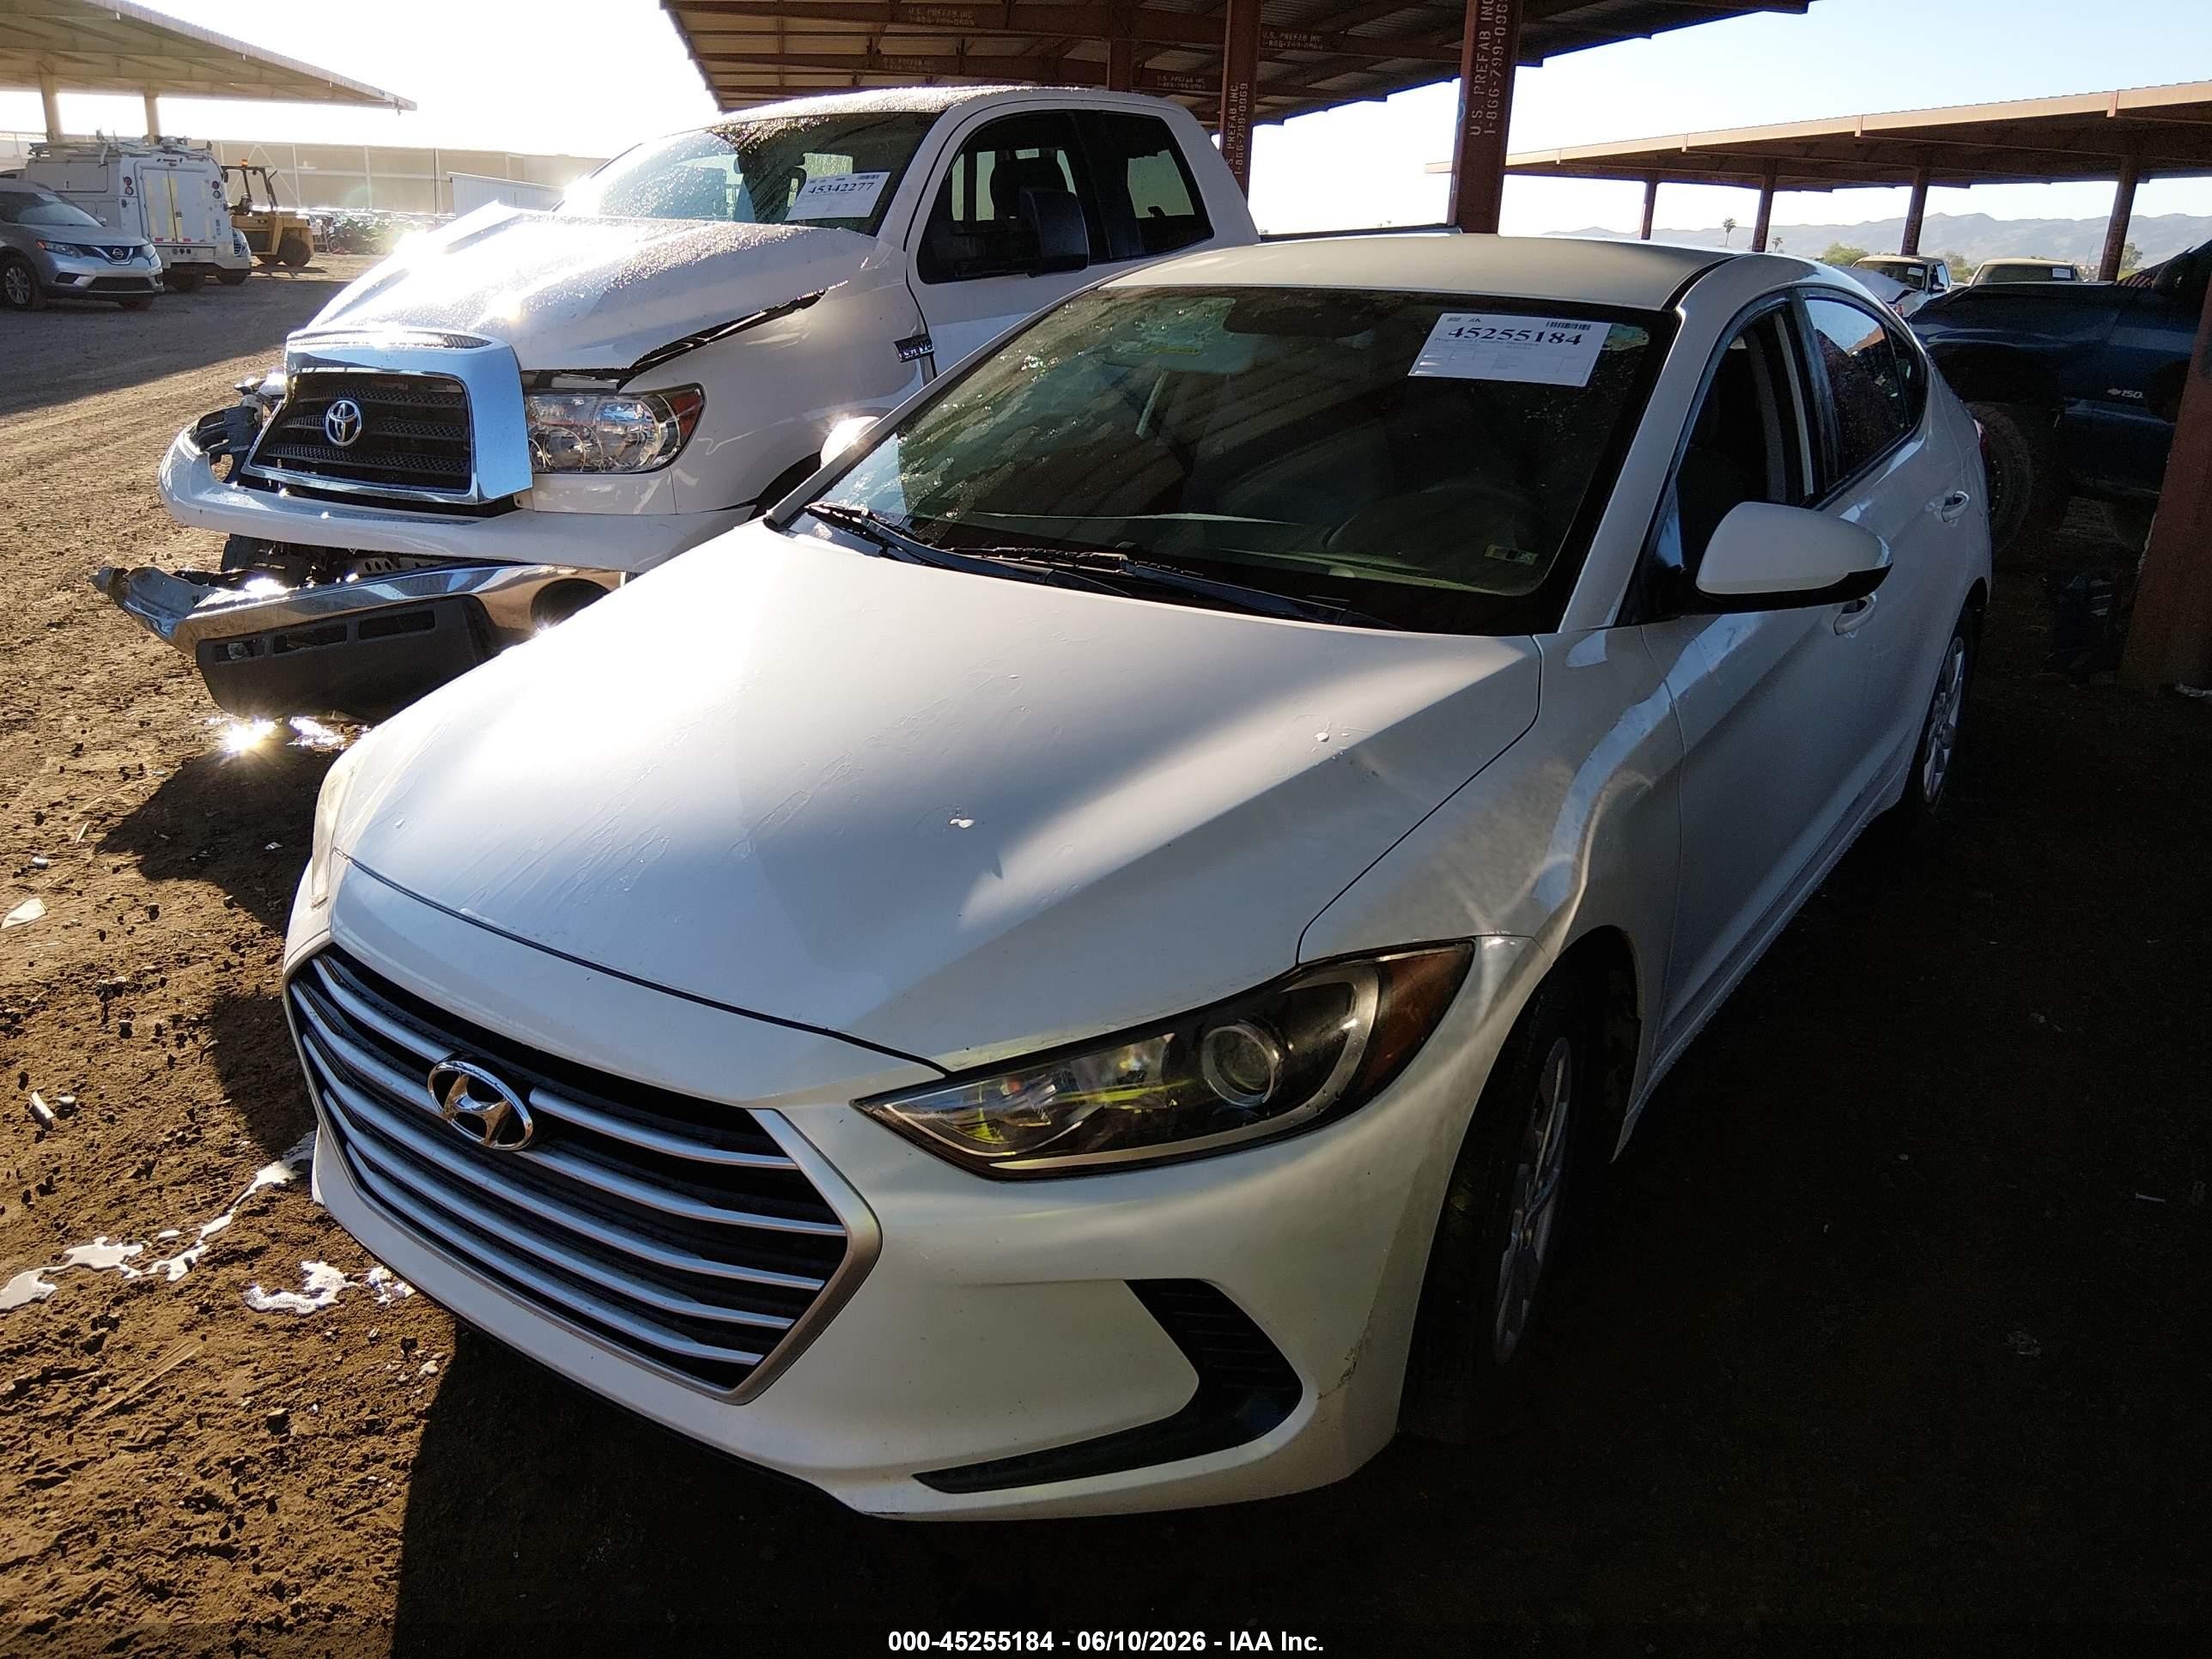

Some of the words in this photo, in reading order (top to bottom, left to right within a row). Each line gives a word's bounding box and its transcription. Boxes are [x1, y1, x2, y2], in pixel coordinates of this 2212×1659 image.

[1474, 30, 1492, 94] PREFAB
[1484, 0, 1509, 135] 1-866-799-096
[1227, 108, 1237, 149] PREFAB
[1234, 82, 1249, 175] 1-866-799-0969
[807, 182, 875, 194] 45342277
[1448, 326, 1583, 345] 45255184
